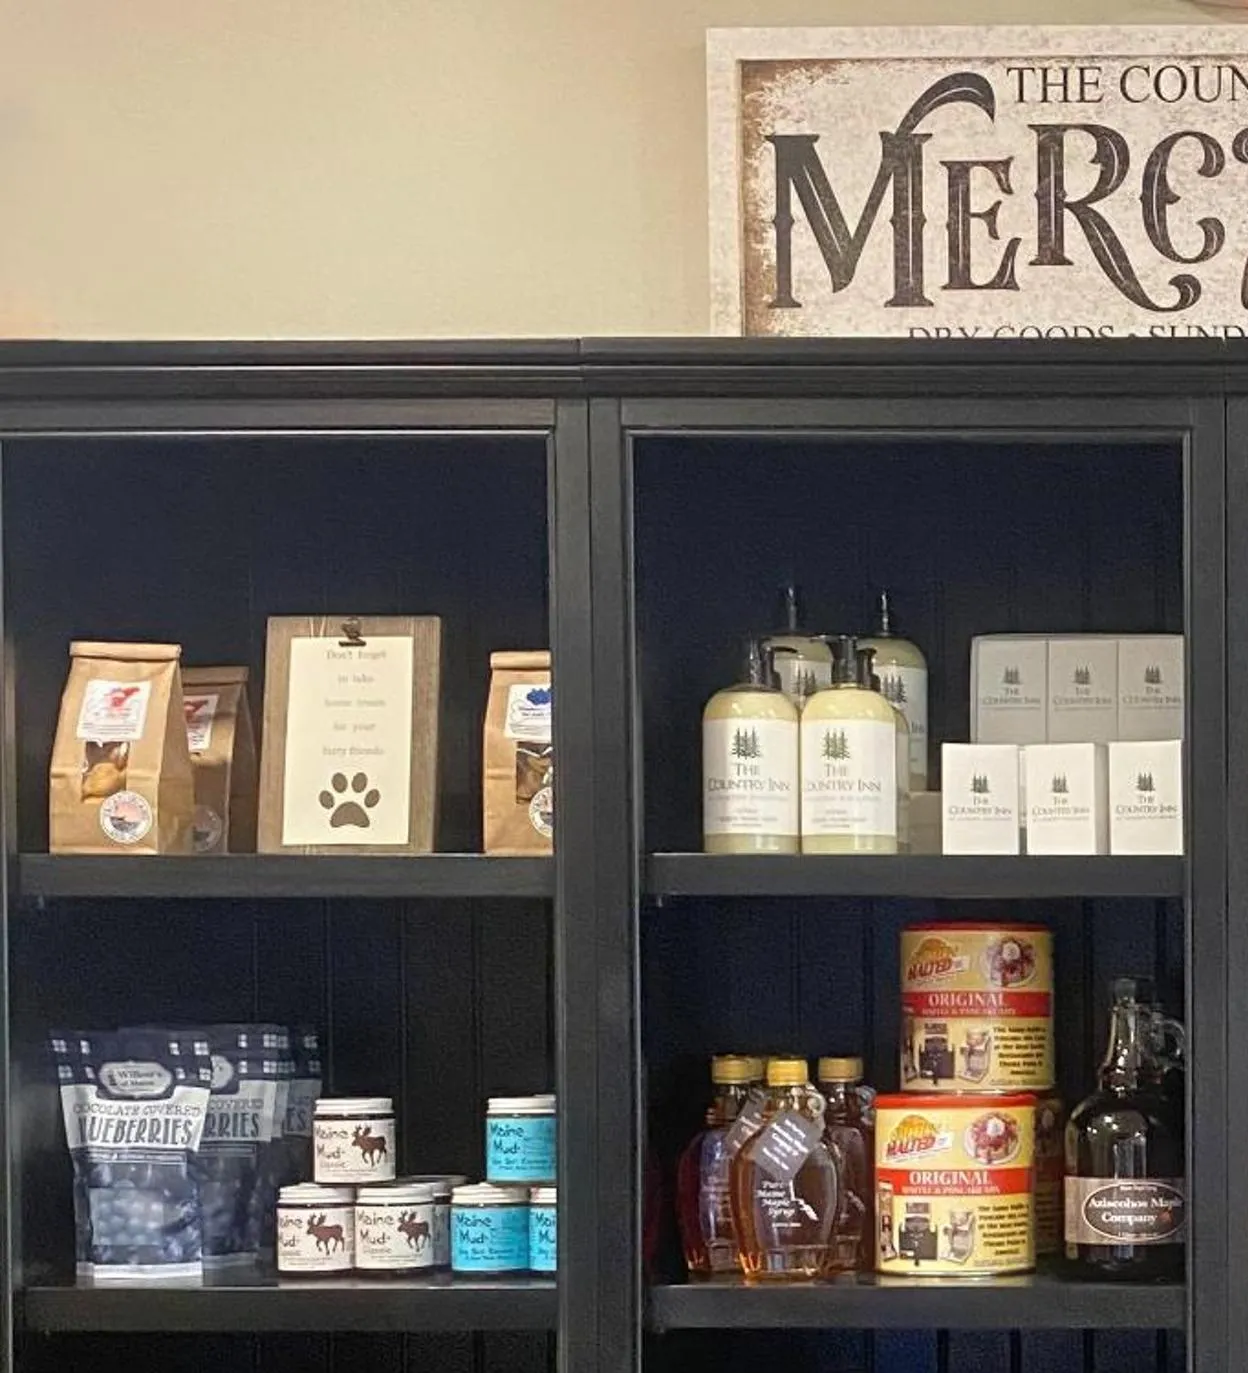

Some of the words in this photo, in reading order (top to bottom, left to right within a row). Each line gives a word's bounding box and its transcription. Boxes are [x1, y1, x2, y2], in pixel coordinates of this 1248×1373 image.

[1006, 65, 1103, 103] THE
[858, 778, 882, 793] INN
[927, 992, 1006, 1007] ORIGINAL
[908, 1170, 990, 1186] ORIGINAL
[1101, 1211, 1158, 1226] Company
